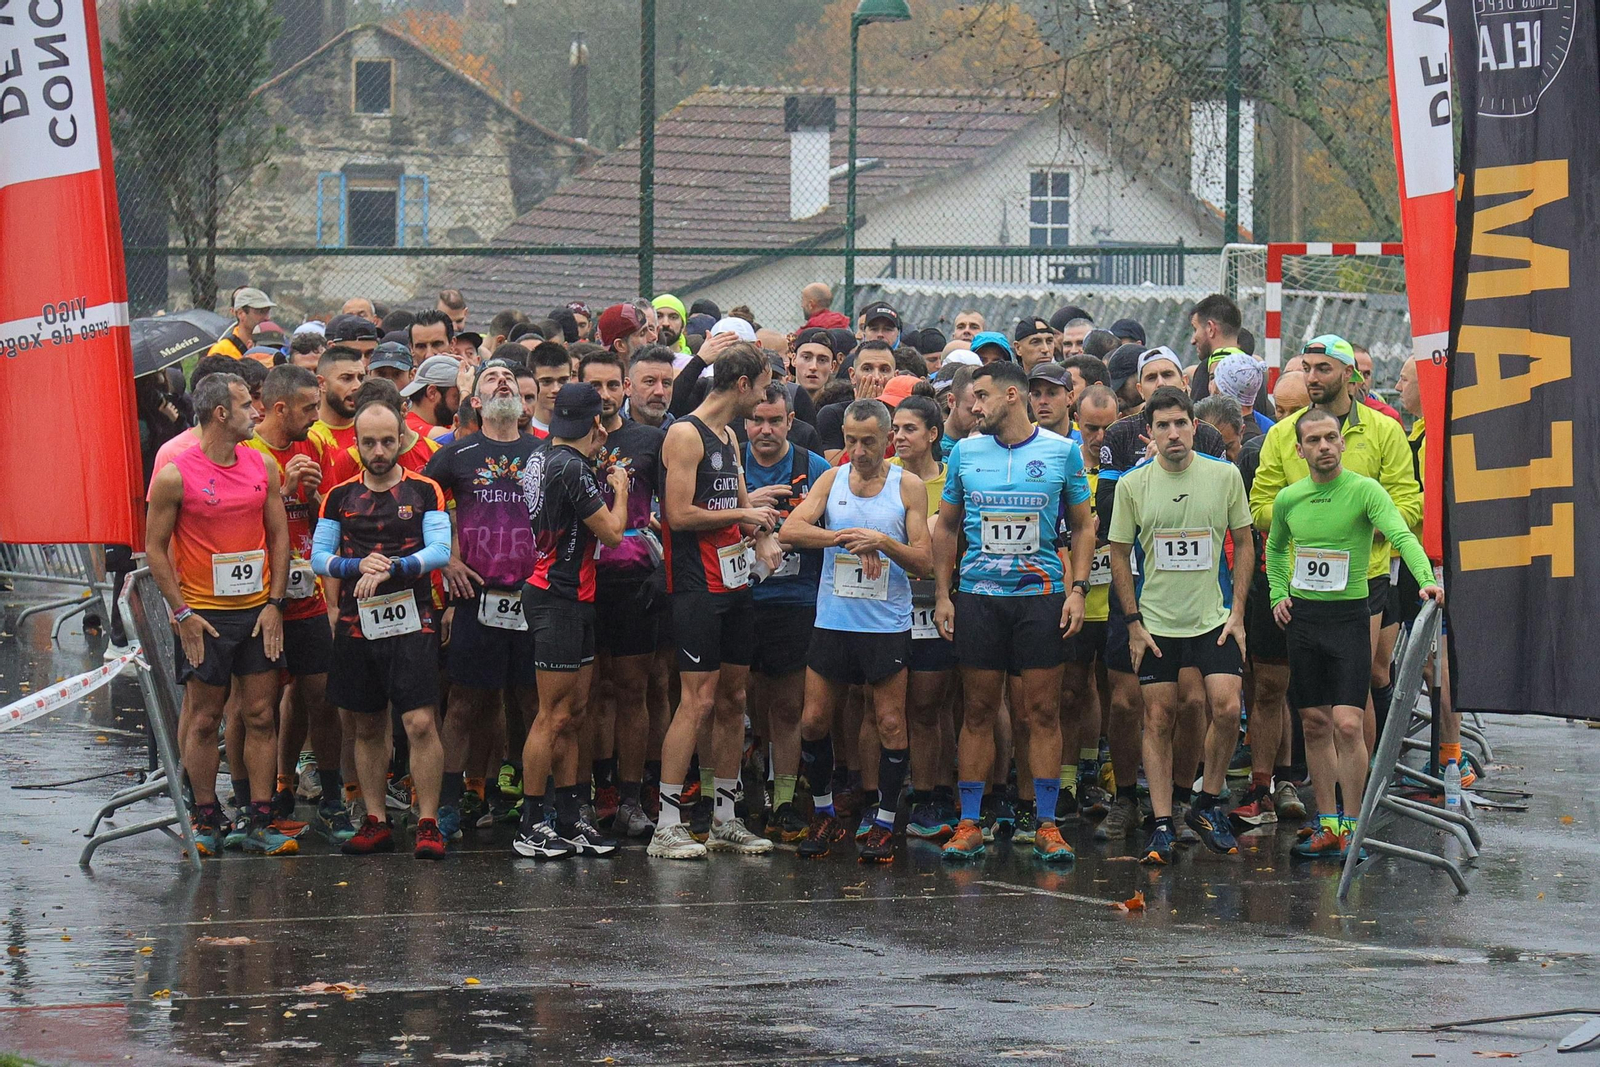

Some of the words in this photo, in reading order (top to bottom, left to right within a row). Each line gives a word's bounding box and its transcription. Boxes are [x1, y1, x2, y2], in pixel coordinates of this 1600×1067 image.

[159, 334, 200, 358] Madeira
[985, 495, 1043, 506] PLASTIFER
[991, 524, 1027, 540] 117
[1164, 540, 1199, 557] 131
[231, 563, 253, 580] 49
[729, 553, 747, 573] 105
[1307, 561, 1330, 577] 90
[370, 604, 407, 625] 140
[497, 598, 522, 616] 84
